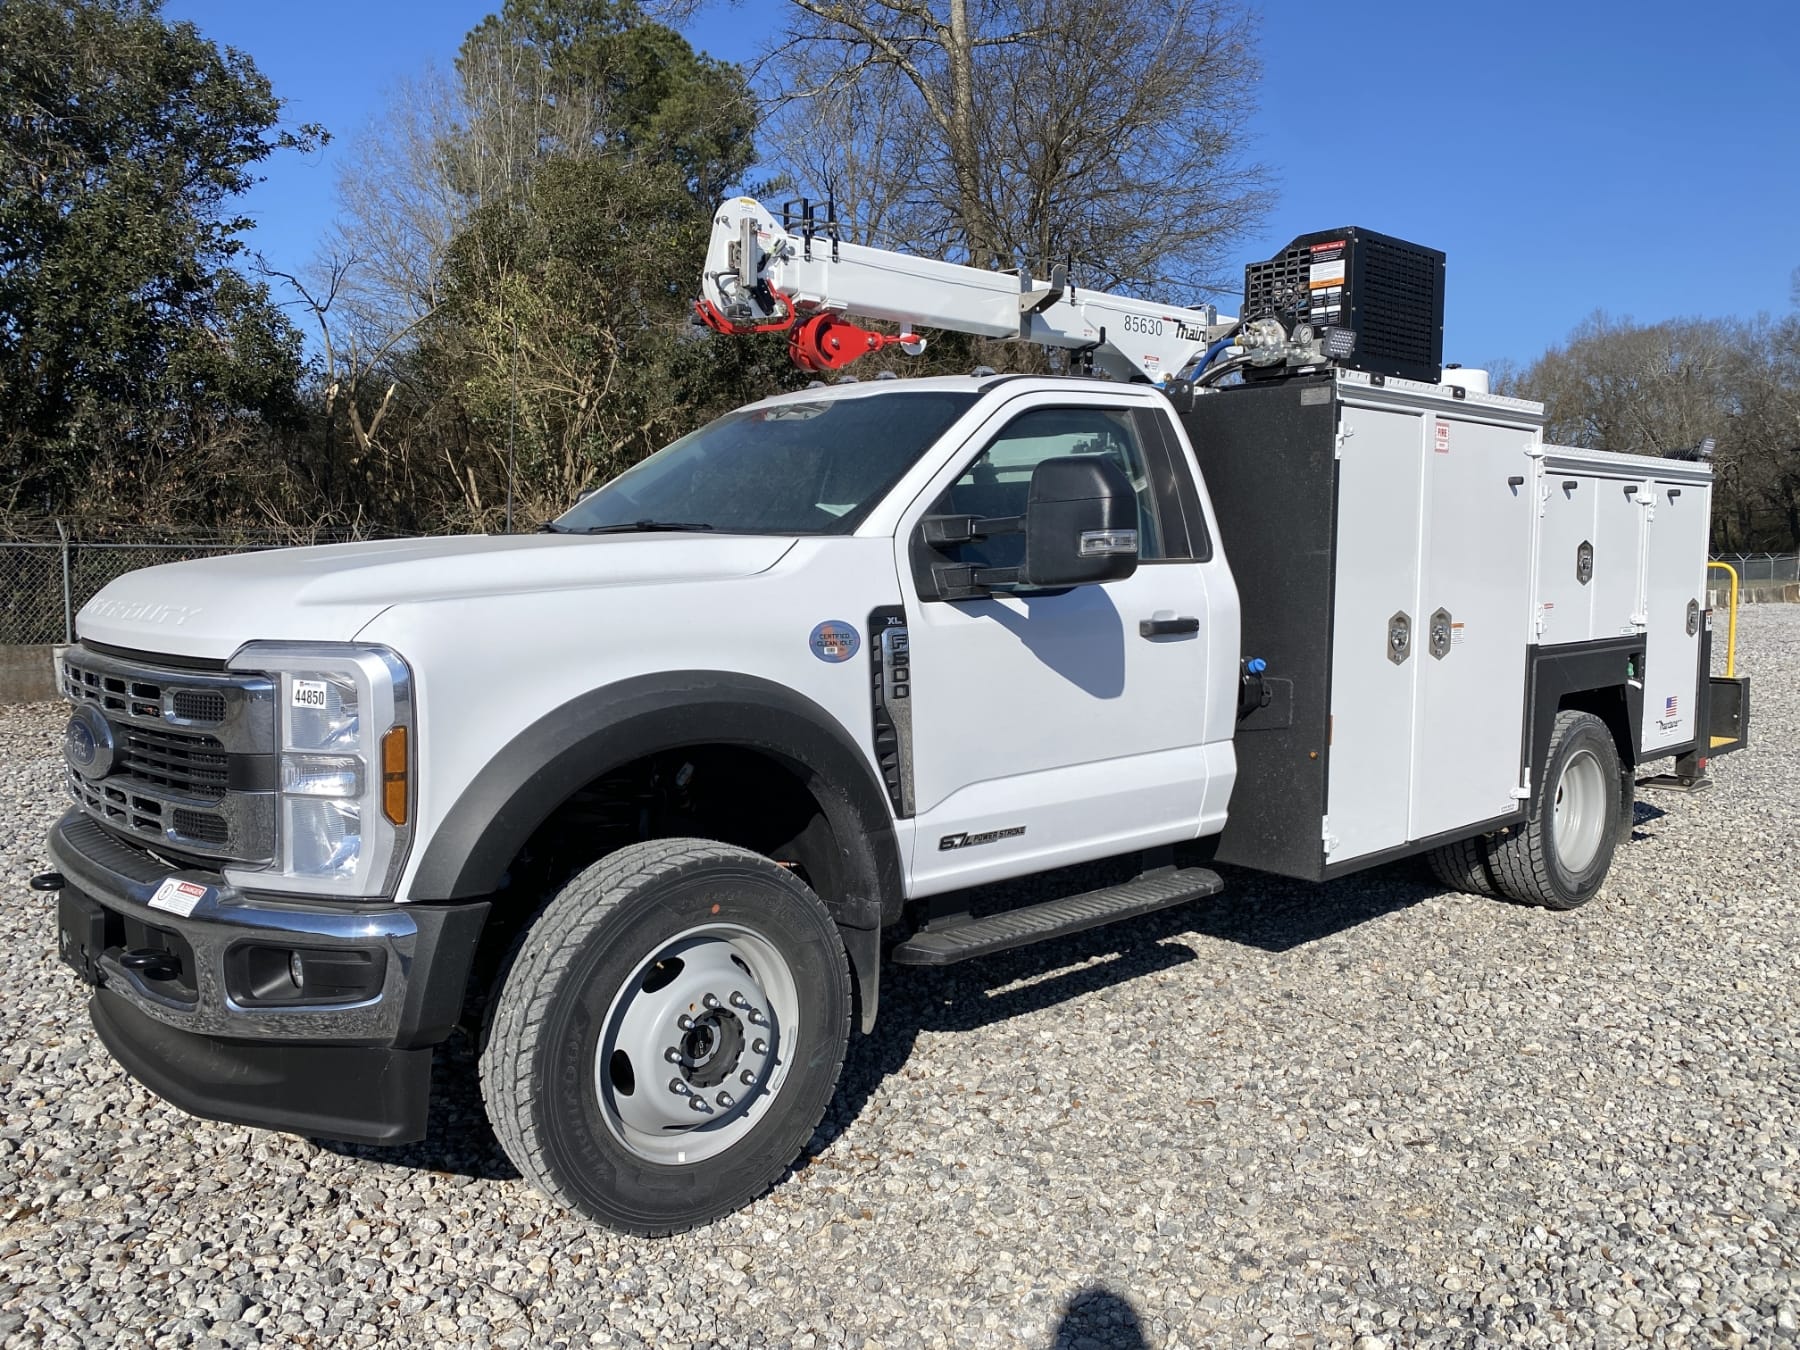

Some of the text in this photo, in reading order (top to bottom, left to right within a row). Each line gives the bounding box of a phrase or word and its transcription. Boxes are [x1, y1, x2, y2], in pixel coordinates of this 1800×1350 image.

[1124, 315, 1163, 337] 85630
[1172, 318, 1207, 342] Main
[887, 616, 903, 625] XL
[816, 639, 854, 648] CLEAN IDLE
[295, 689, 325, 705] 44850
[973, 830, 998, 842] POWER
[999, 826, 1026, 838] STROKE
